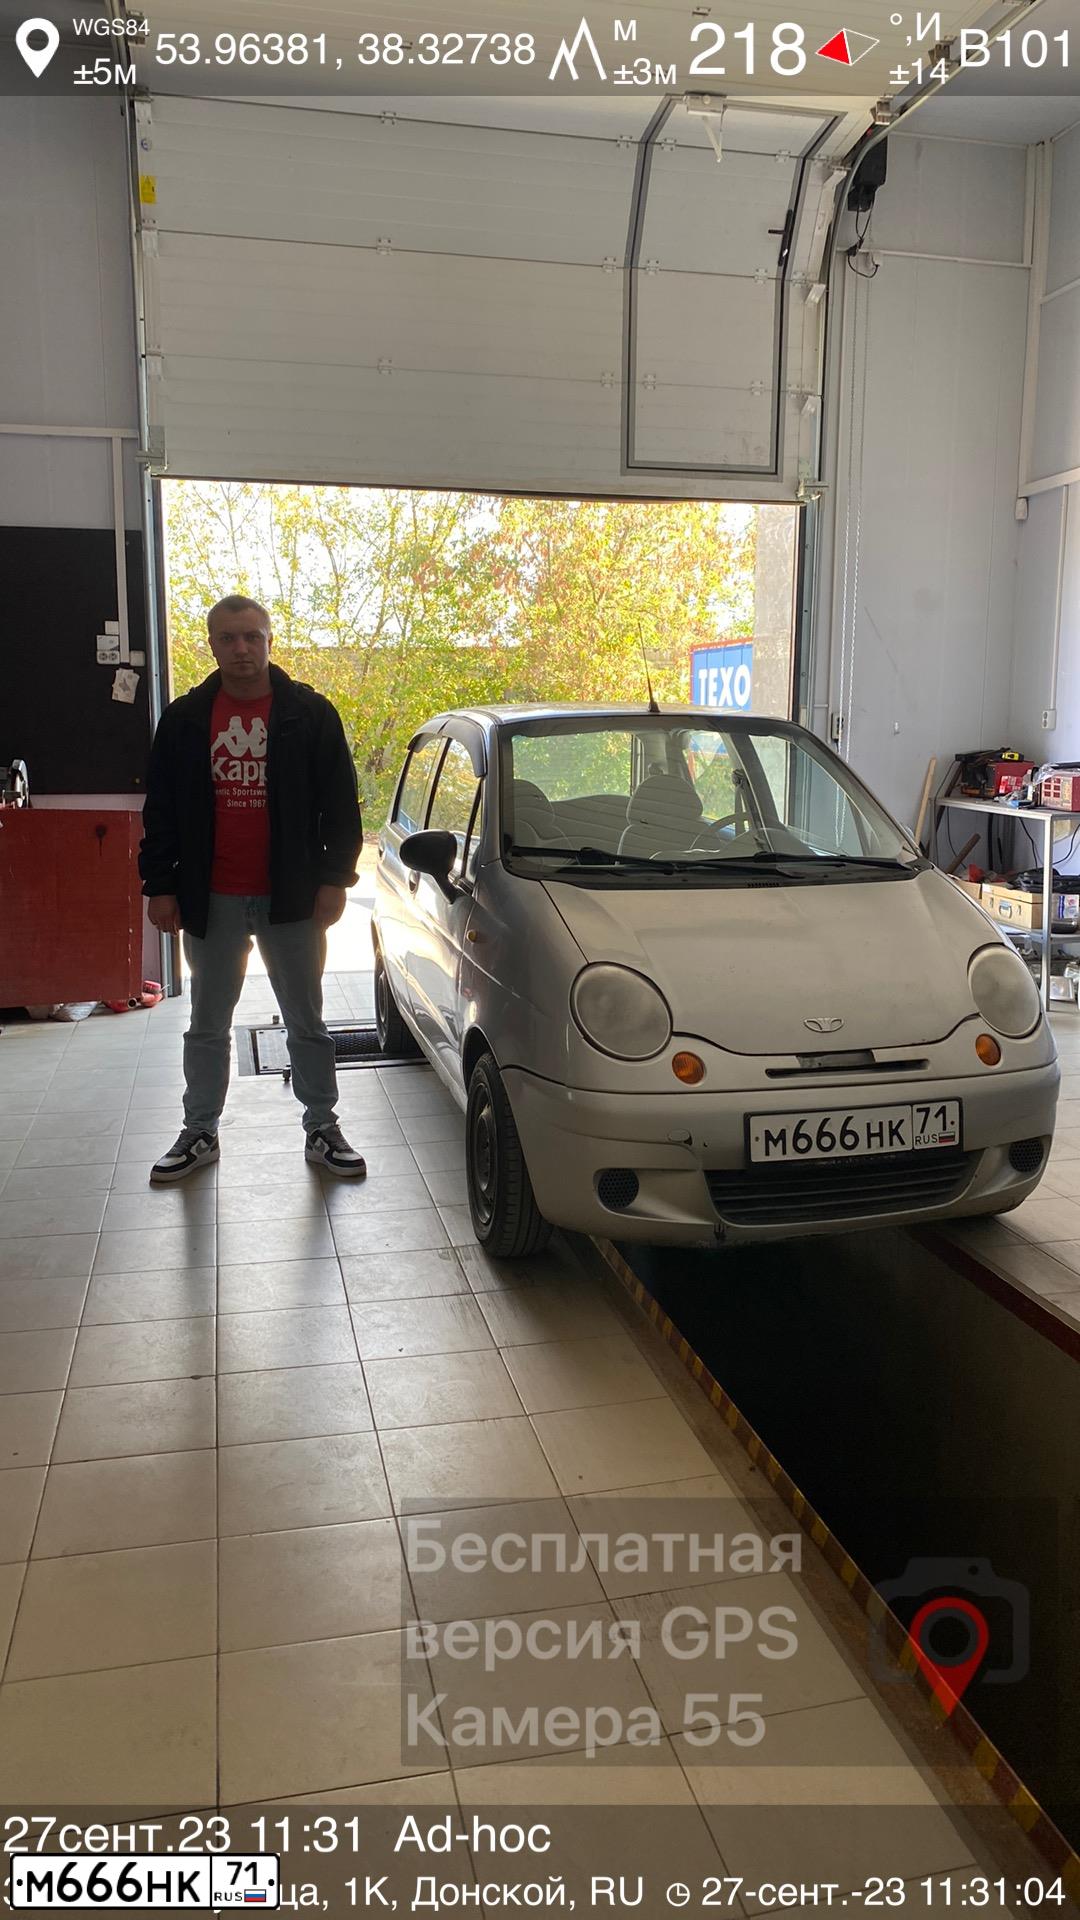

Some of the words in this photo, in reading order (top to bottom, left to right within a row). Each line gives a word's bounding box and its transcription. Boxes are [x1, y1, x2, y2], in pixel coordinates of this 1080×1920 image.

[227, 799, 247, 808] Since
[249, 799, 267, 808] 1967
[764, 1115, 906, 1157] М666НК
[916, 1105, 948, 1134] 71
[915, 1132, 938, 1145] RUS
